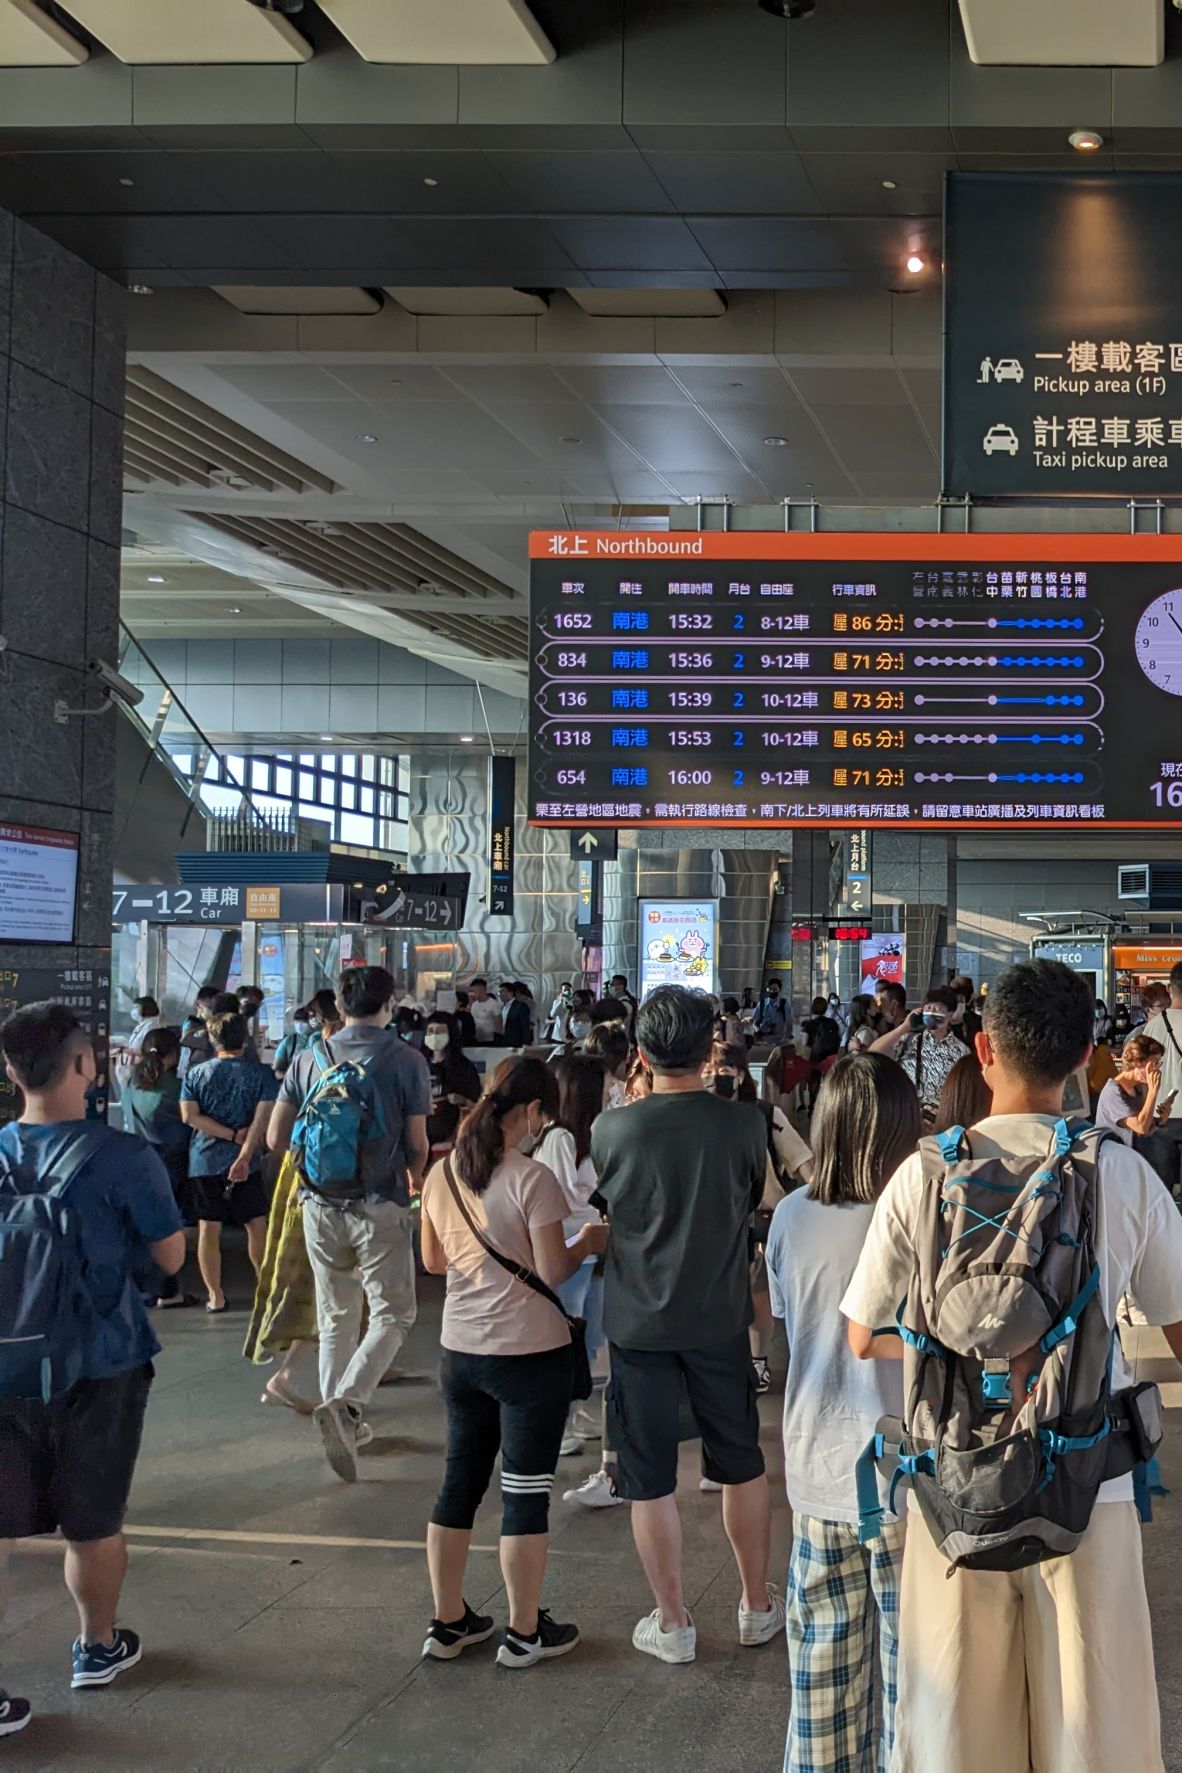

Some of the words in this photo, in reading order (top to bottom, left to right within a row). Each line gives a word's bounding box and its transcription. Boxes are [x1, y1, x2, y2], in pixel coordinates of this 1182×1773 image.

[1034, 376, 1089, 396] Pickup
[1095, 380, 1130, 393] area
[1136, 377, 1166, 396] (1F)
[1034, 452, 1066, 468] Taxi
[1071, 452, 1128, 472] pickup
[1132, 455, 1168, 469] area
[548, 536, 588, 555] 北上
[597, 538, 702, 554] Northbound
[561, 583, 585, 595] 車次
[728, 583, 751, 596] 月台
[760, 584, 794, 596] 自由座
[832, 584, 877, 597] 行車資訊
[1164, 602, 1174, 611] 11
[554, 614, 592, 629] 1652
[612, 611, 649, 630] 南港
[668, 614, 713, 629] 15:32
[734, 615, 744, 629] 2
[761, 614, 810, 630] 8-12車
[852, 616, 872, 631] 86
[1148, 617, 1159, 627] 10
[1142, 638, 1150, 648] 9
[558, 652, 587, 668] 834
[612, 650, 649, 669] 南港
[668, 653, 713, 668] 15:36
[733, 653, 744, 668] 2
[761, 653, 810, 669] 9-12車
[852, 655, 870, 669] 71
[1149, 660, 1157, 670] 8
[1164, 675, 1171, 684] 7
[558, 692, 587, 707] 136
[611, 689, 649, 708] 南港
[668, 692, 712, 707] 15:39
[733, 693, 744, 707] 2
[761, 692, 819, 708] 10-12車
[852, 694, 871, 708] 73
[553, 731, 591, 746] 1318
[611, 728, 648, 747] 南港
[668, 731, 712, 746] 15:53
[733, 732, 744, 746] 2
[761, 731, 819, 747] 10-12車
[852, 733, 872, 748] 65
[557, 770, 586, 785] 654
[611, 768, 648, 786] 南港
[668, 770, 712, 785] 16:00
[733, 771, 744, 785] 2
[761, 769, 810, 786] 9-12車
[852, 772, 870, 786] 71
[852, 881, 862, 894] 2
[199, 886, 240, 907] 車廂
[200, 907, 222, 919] Car
[407, 899, 438, 922] 7-12
[1055, 953, 1082, 964] TECO
[1136, 953, 1158, 963] Miss
